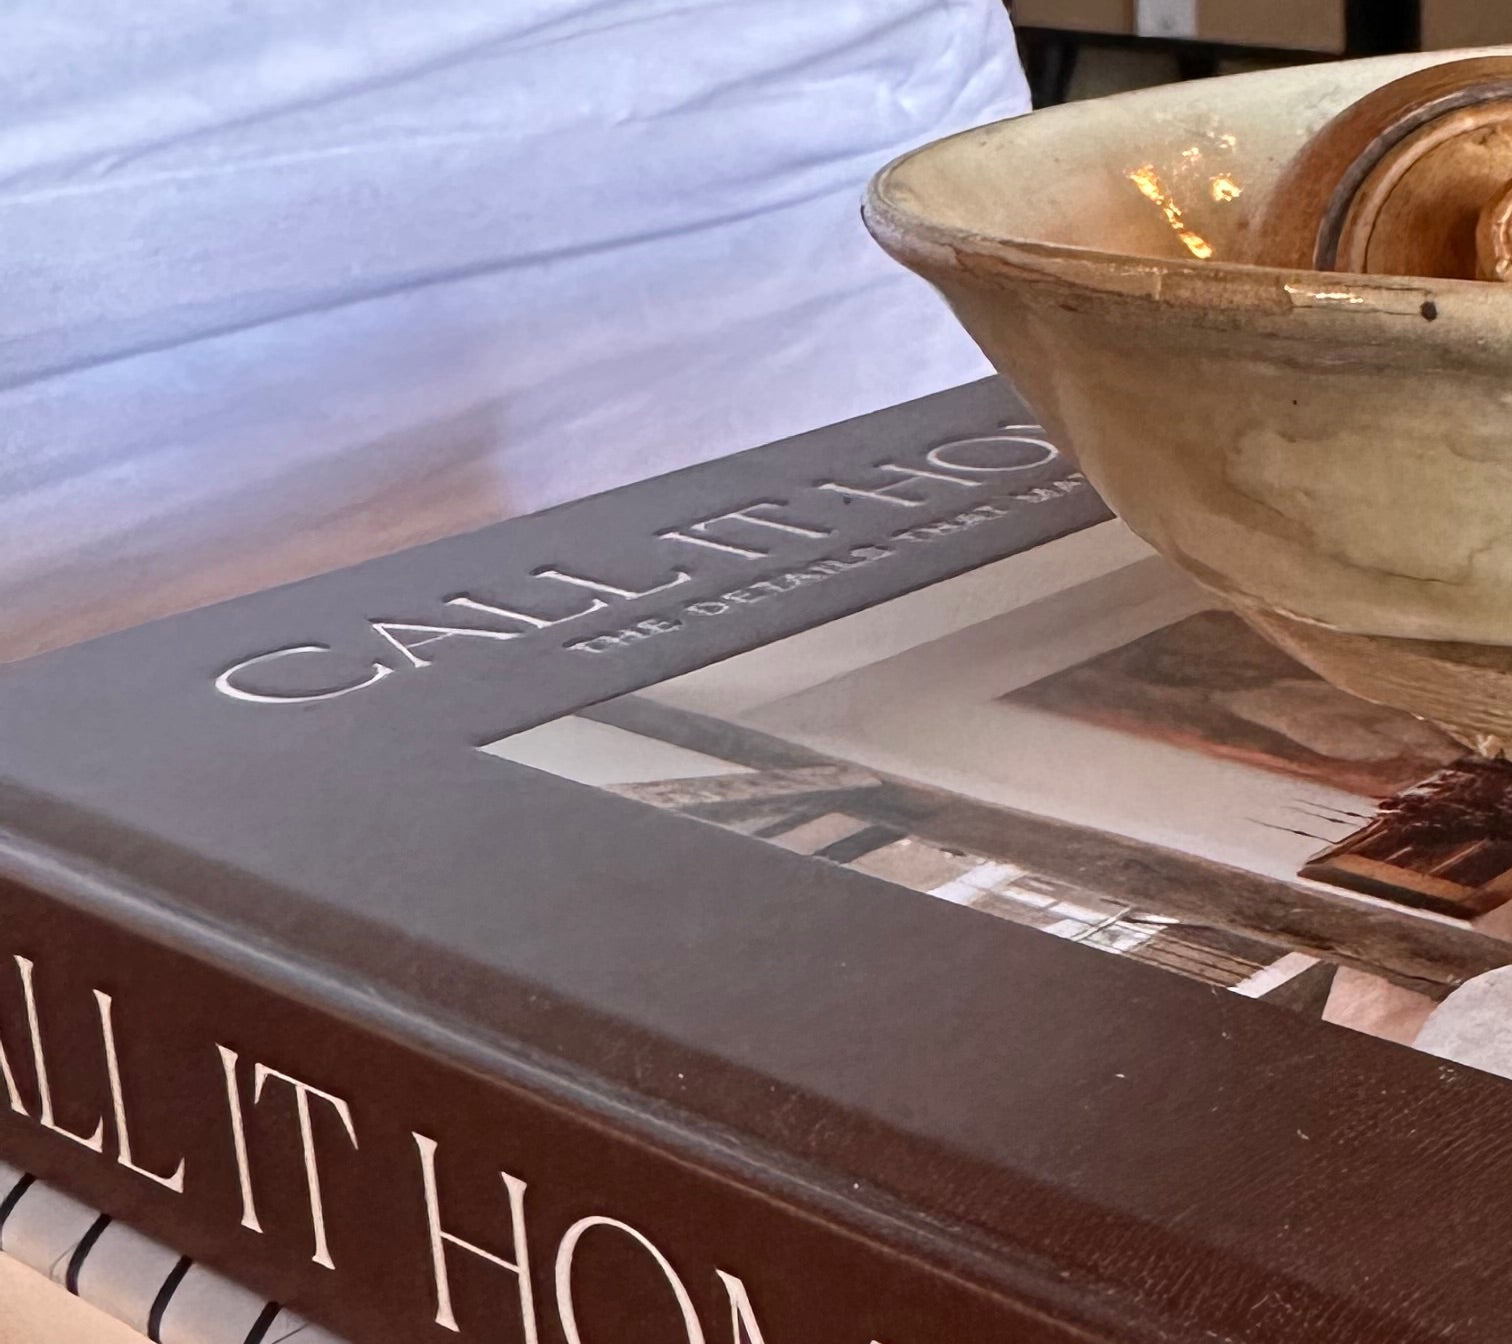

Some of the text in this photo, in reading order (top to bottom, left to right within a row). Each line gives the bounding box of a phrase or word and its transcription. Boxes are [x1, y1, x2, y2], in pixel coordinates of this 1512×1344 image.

[214, 424, 1060, 704] CALL IT HO
[564, 618, 682, 654] THE
[689, 545, 896, 617] DETAILS
[891, 505, 1008, 541] THAT
[0, 955, 185, 1194] LL
[215, 1042, 359, 1270] IT
